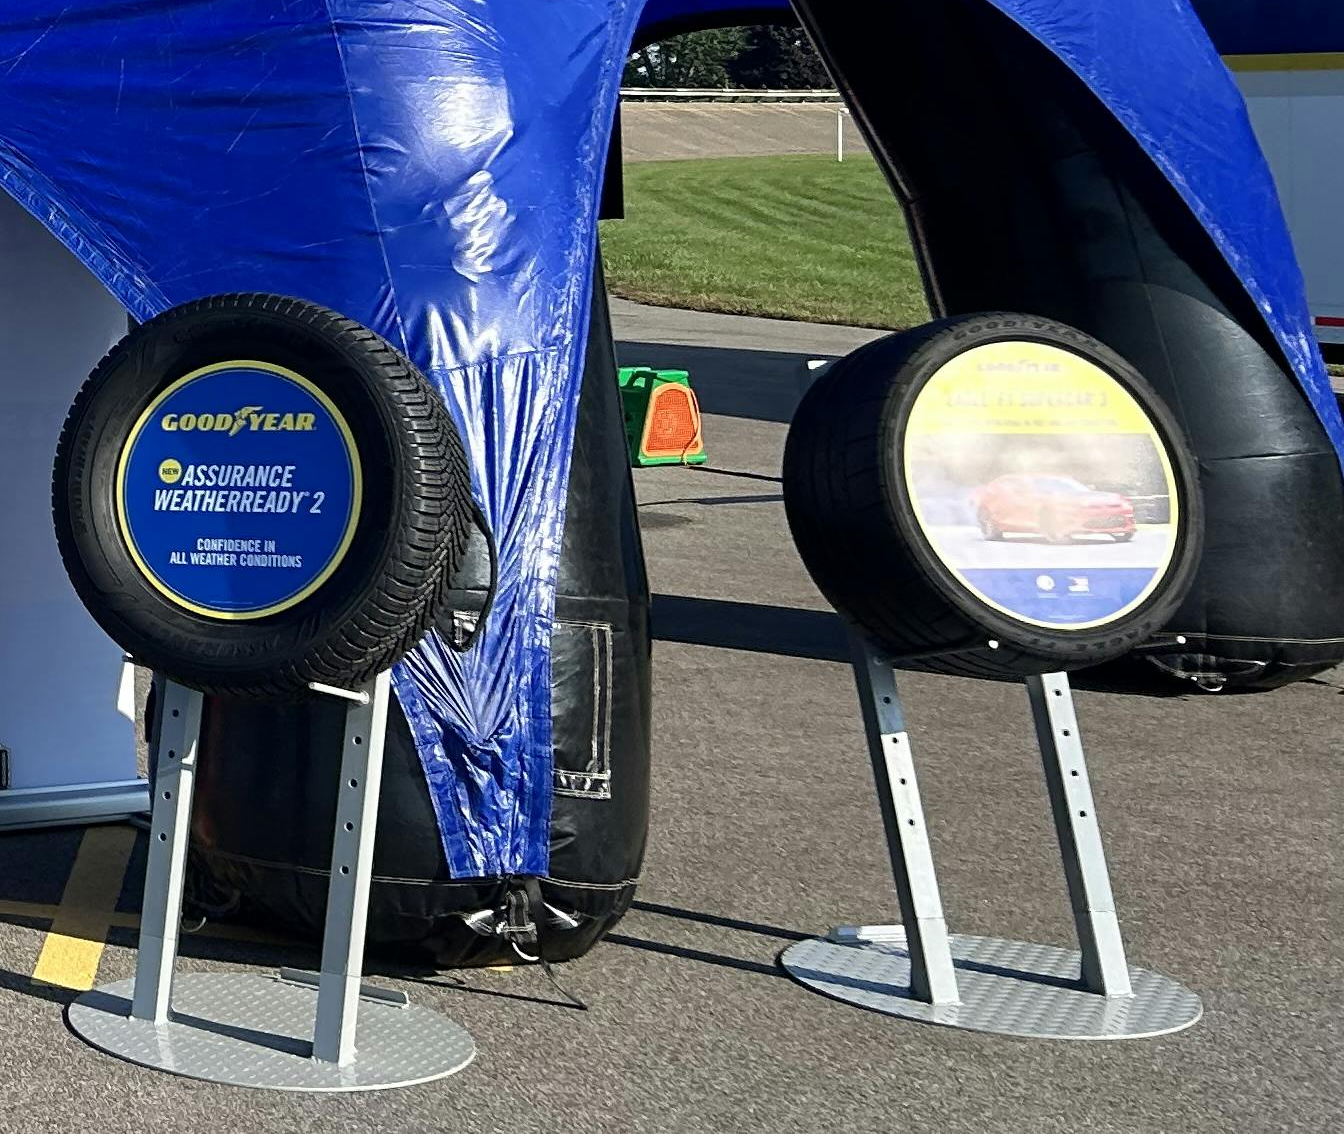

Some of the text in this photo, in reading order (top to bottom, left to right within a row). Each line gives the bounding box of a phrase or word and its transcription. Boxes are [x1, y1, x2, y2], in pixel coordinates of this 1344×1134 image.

[162, 414, 315, 431] GOODYEAR
[181, 465, 296, 488] ASSURANCE
[154, 490, 325, 513] WEATHERREADY 2
[197, 538, 276, 552] CONFIDENCE IN
[169, 552, 302, 567] ALL WEATHER CONDITIONS
